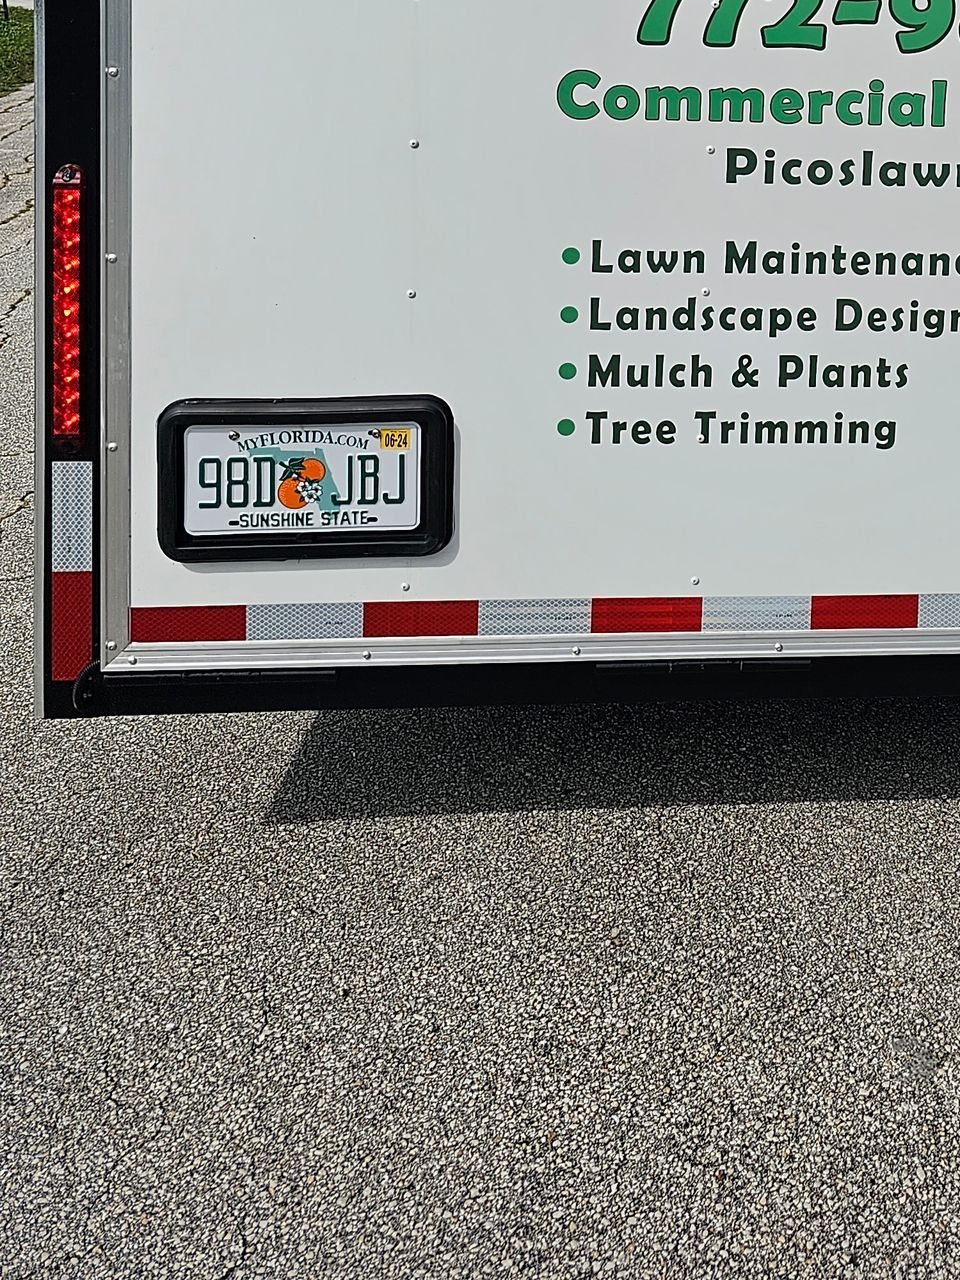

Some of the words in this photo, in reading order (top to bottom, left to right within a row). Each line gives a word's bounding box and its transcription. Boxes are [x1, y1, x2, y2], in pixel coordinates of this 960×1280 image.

[557, 69, 947, 128] Commercial
[591, 239, 705, 274] Lawn
[590, 297, 817, 338] Landscape
[587, 354, 713, 388] Mulch
[731, 354, 760, 388] &
[778, 355, 910, 389] Plants
[238, 430, 370, 452] MYFLORIDA.COM
[384, 432, 408, 448] 06-24
[585, 411, 677, 444] Tree
[695, 411, 897, 449] Trimming
[198, 456, 277, 508] 98D
[331, 453, 406, 505] JBJ
[239, 512, 315, 528] SUNSHINE
[321, 510, 369, 525] STATE
